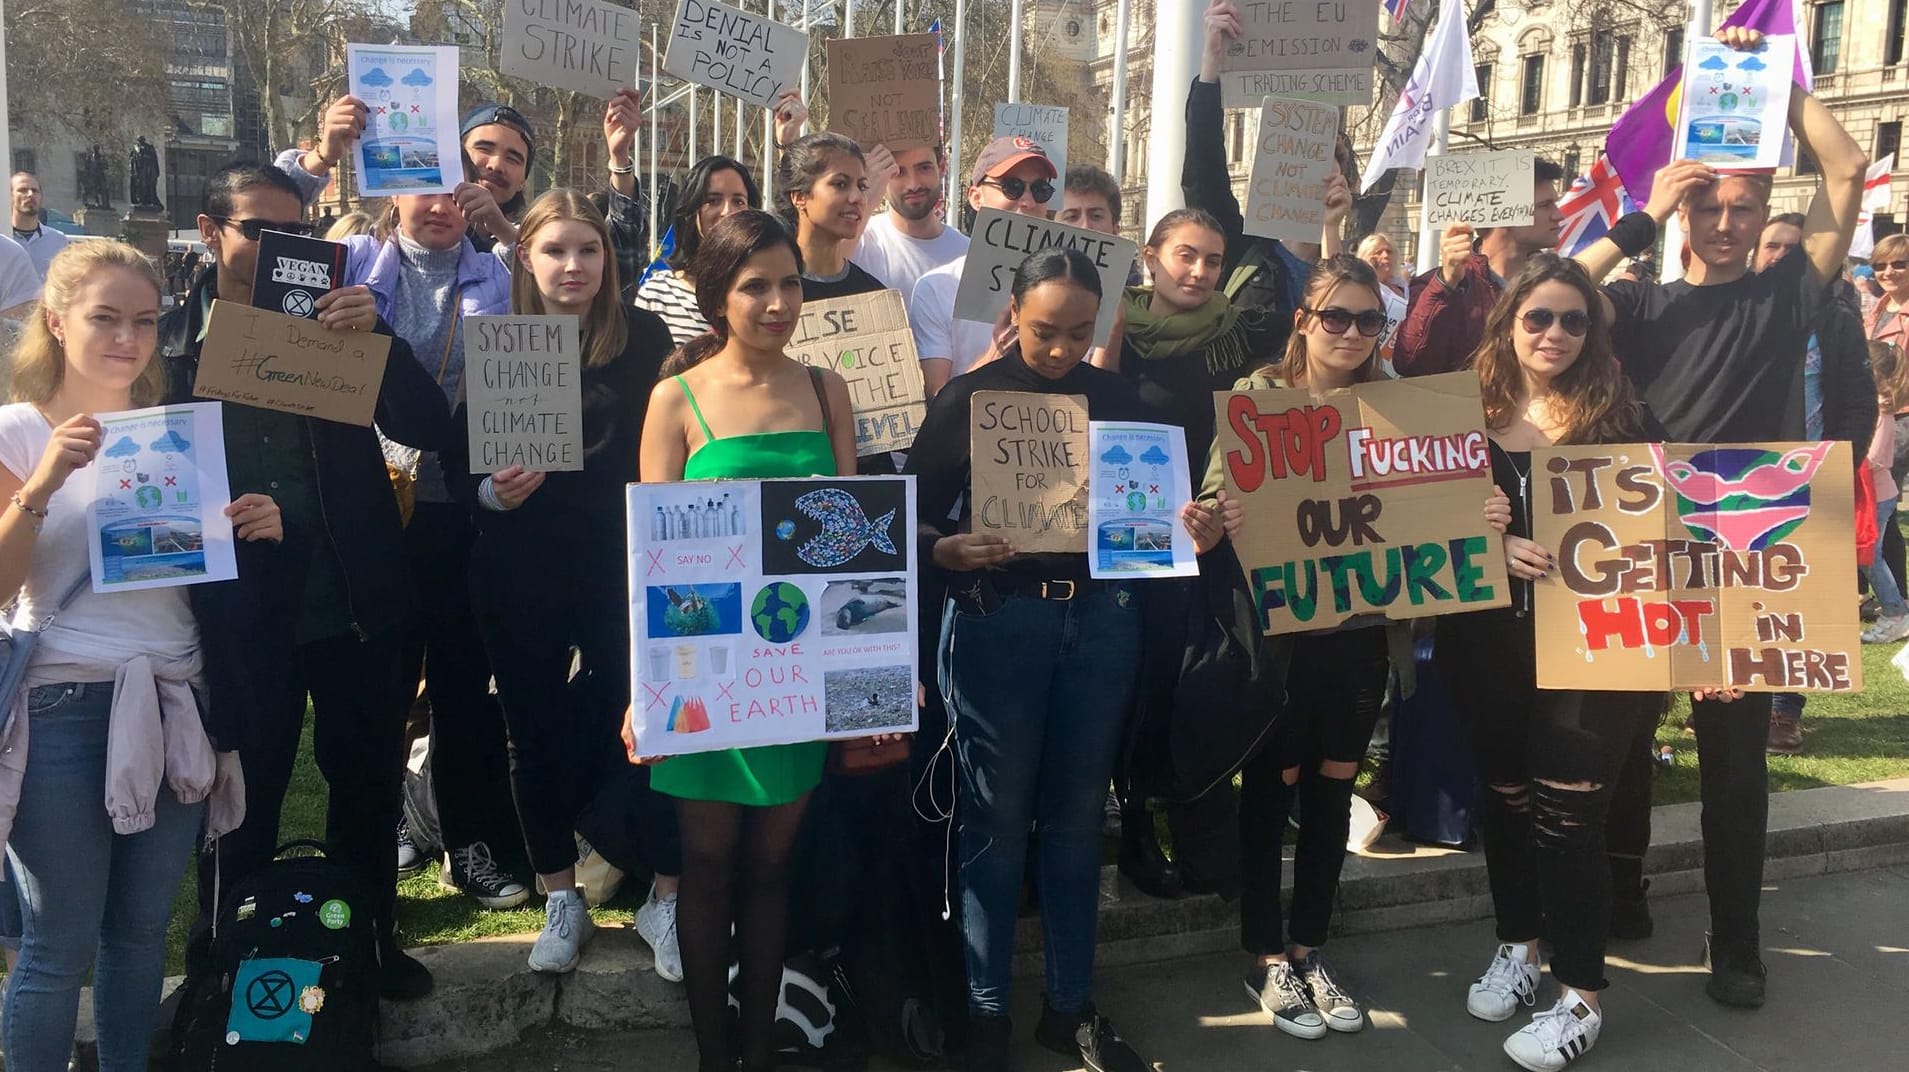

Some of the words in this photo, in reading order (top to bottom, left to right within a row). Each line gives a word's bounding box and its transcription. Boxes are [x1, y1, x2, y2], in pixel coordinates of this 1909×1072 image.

[683, 0, 774, 54] DENIAL
[1246, 2, 1297, 24] THE
[1317, 3, 1345, 23] EU
[521, 24, 624, 83] STRIKE
[678, 24, 702, 41] IS
[715, 40, 751, 64] NOT
[758, 58, 772, 74] A
[1247, 37, 1341, 58] EMISSION
[692, 50, 782, 104] POLICY
[1240, 74, 1307, 95] TRADING
[1308, 73, 1366, 94] SCHEME
[870, 93, 904, 108] NOT
[1001, 105, 1065, 127] CLIMATE
[1267, 101, 1337, 137] SYSTEM
[1263, 133, 1329, 161] CHANGE
[1275, 161, 1308, 179] NOT
[1515, 155, 1531, 171] IS
[1436, 191, 1506, 207] CLIMATE
[1256, 203, 1320, 225] CHANGE
[1429, 208, 1486, 223] CHANGES
[278, 258, 329, 275] VEGAN
[244, 314, 259, 340] I
[287, 324, 344, 353] Demand
[353, 350, 365, 361] a
[478, 322, 562, 354] SYSTEM
[797, 310, 857, 344] ISE
[823, 343, 905, 373] VOICE
[483, 358, 569, 389] CHANGE
[846, 373, 909, 405] THE
[110, 422, 138, 434] Change
[140, 421, 146, 430] is
[147, 418, 187, 430] necessary
[482, 410, 569, 435] CLIMATE
[979, 402, 1083, 433] SCHOOL
[483, 441, 572, 466] CHANGE
[994, 438, 1080, 468] STRIKE
[1226, 394, 1342, 493] STOP
[1015, 472, 1048, 491] FOR
[981, 495, 1088, 531] CLIMATE
[1296, 493, 1386, 548] OUR
[677, 555, 694, 565] SAY
[696, 554, 712, 564] NO
[1250, 536, 1495, 630] FUTURE
[1576, 597, 1715, 651] HOT
[752, 643, 805, 658] SAVE
[823, 648, 835, 657] ARE
[837, 647, 852, 656] YOU
[863, 645, 882, 653] WITH
[745, 664, 809, 688] OUR
[1728, 647, 1852, 691] HERE
[729, 694, 819, 723] EARTH
[327, 918, 344, 926] Party
